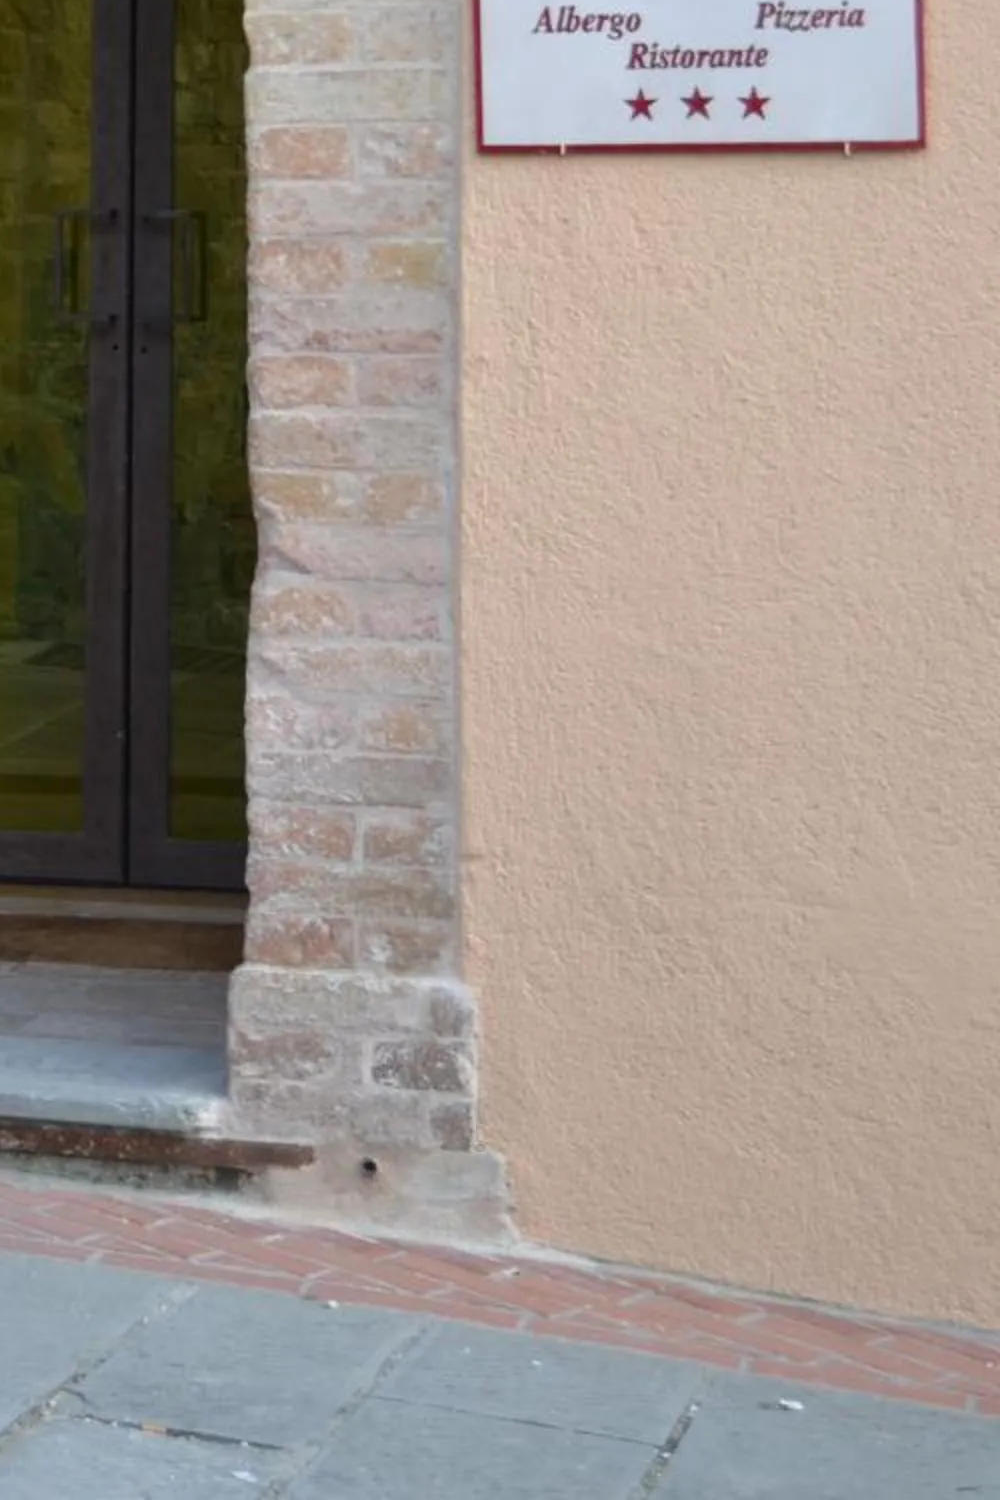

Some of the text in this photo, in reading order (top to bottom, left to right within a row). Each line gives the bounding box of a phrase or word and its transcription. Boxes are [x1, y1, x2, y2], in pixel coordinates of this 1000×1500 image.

[532, 5, 642, 39] Albergo
[754, 1, 865, 32] Pizzeria
[626, 42, 769, 70] Ristorante
